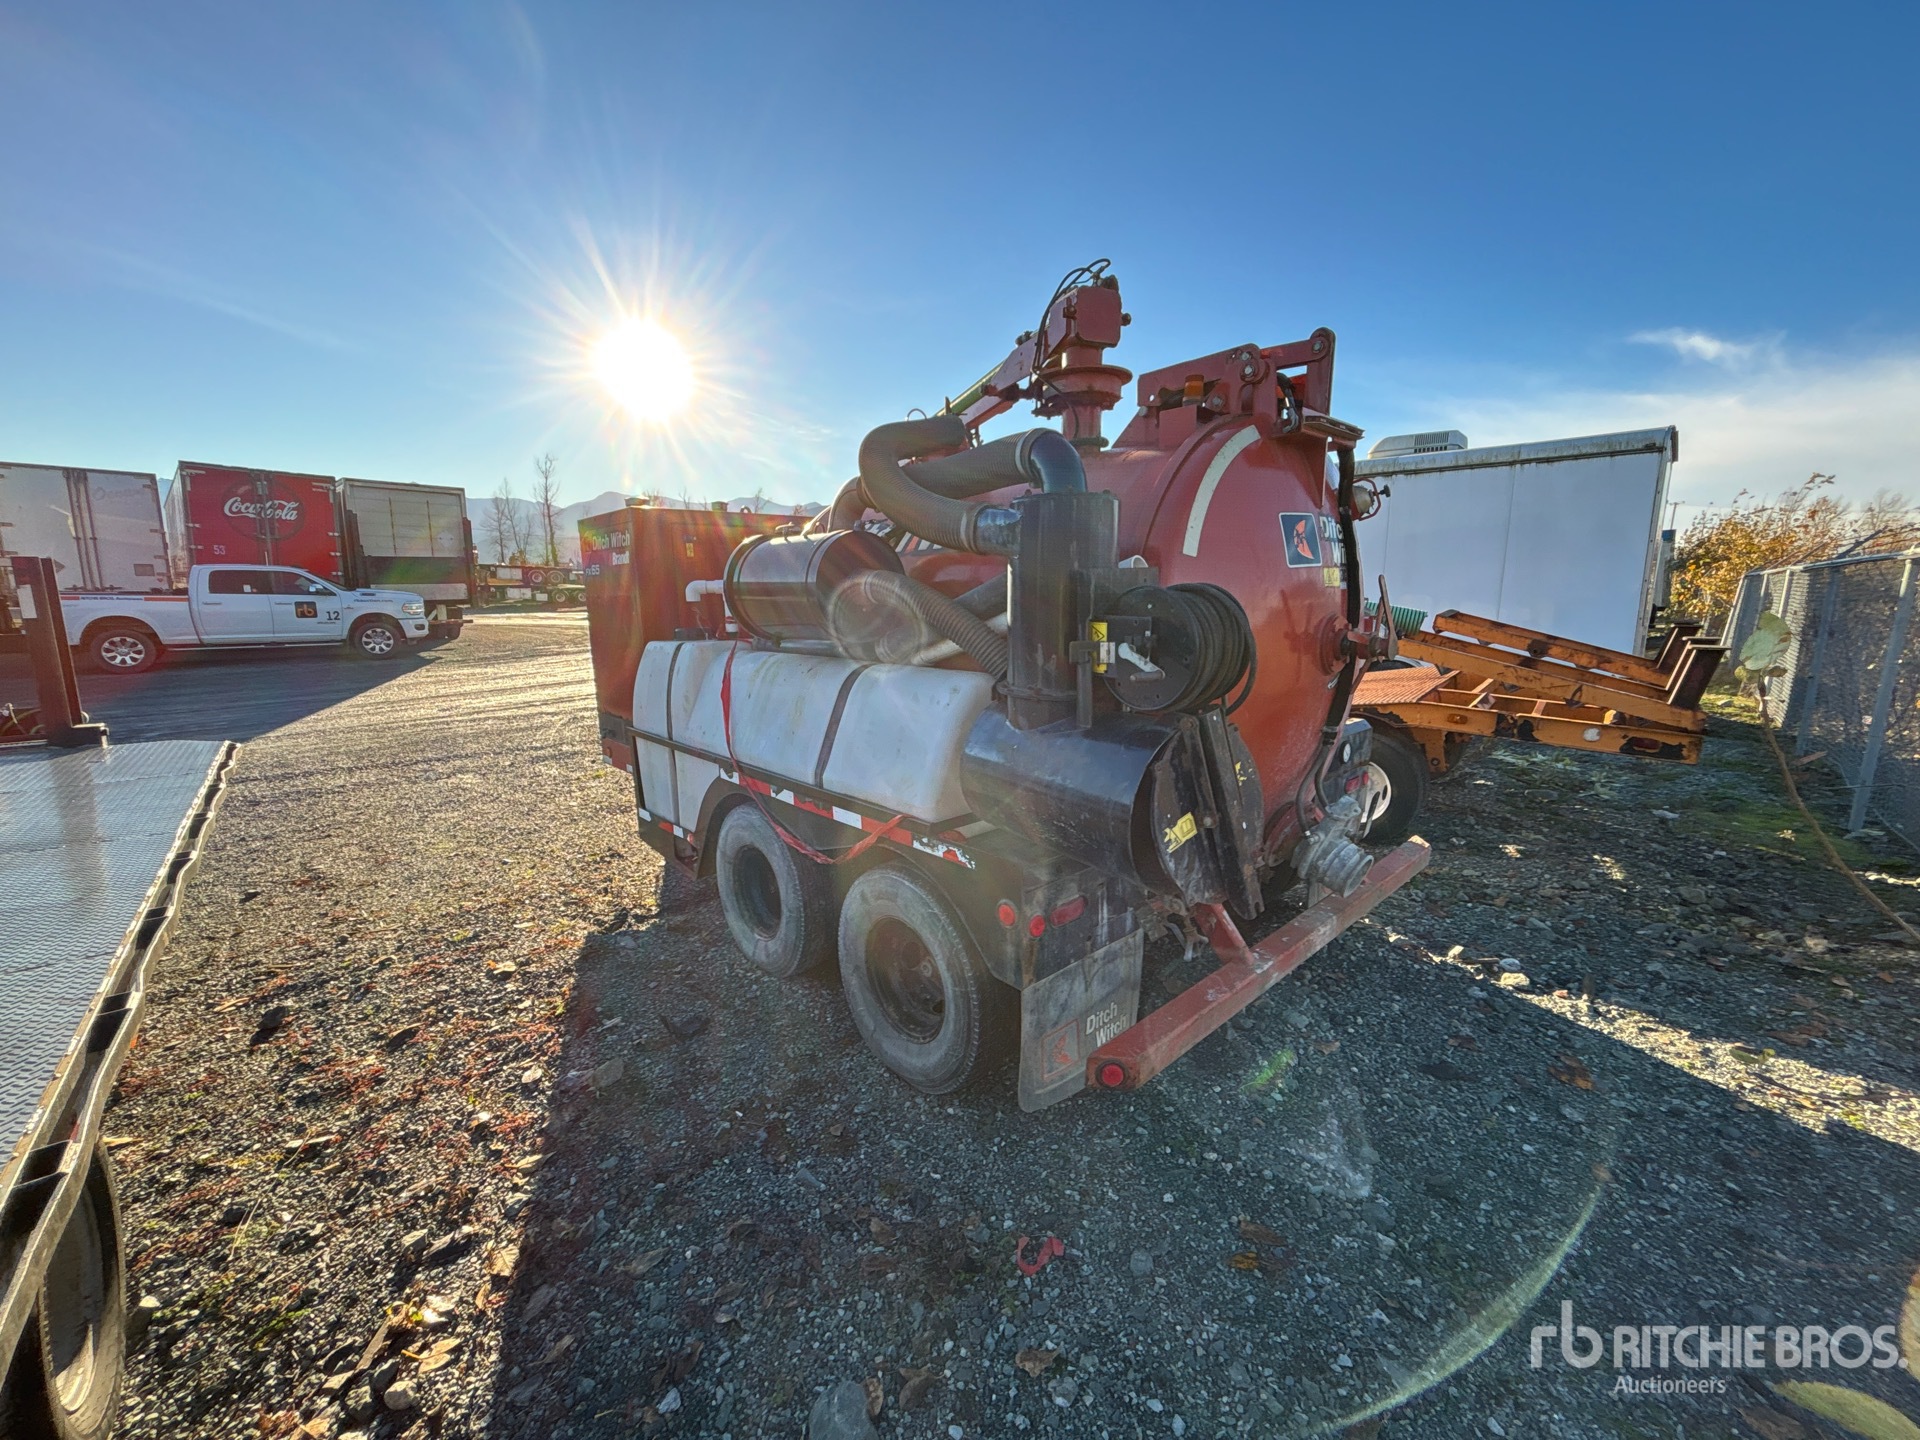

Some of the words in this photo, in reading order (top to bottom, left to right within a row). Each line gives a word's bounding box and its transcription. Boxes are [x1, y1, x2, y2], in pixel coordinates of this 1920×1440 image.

[593, 533, 610, 551] Ditch
[611, 530, 631, 548] Witch
[213, 544, 226, 555] 53
[297, 604, 315, 617] rb
[326, 611, 340, 621] 12
[1086, 1002, 1118, 1035] Ditch
[1096, 1013, 1130, 1048] Witch
